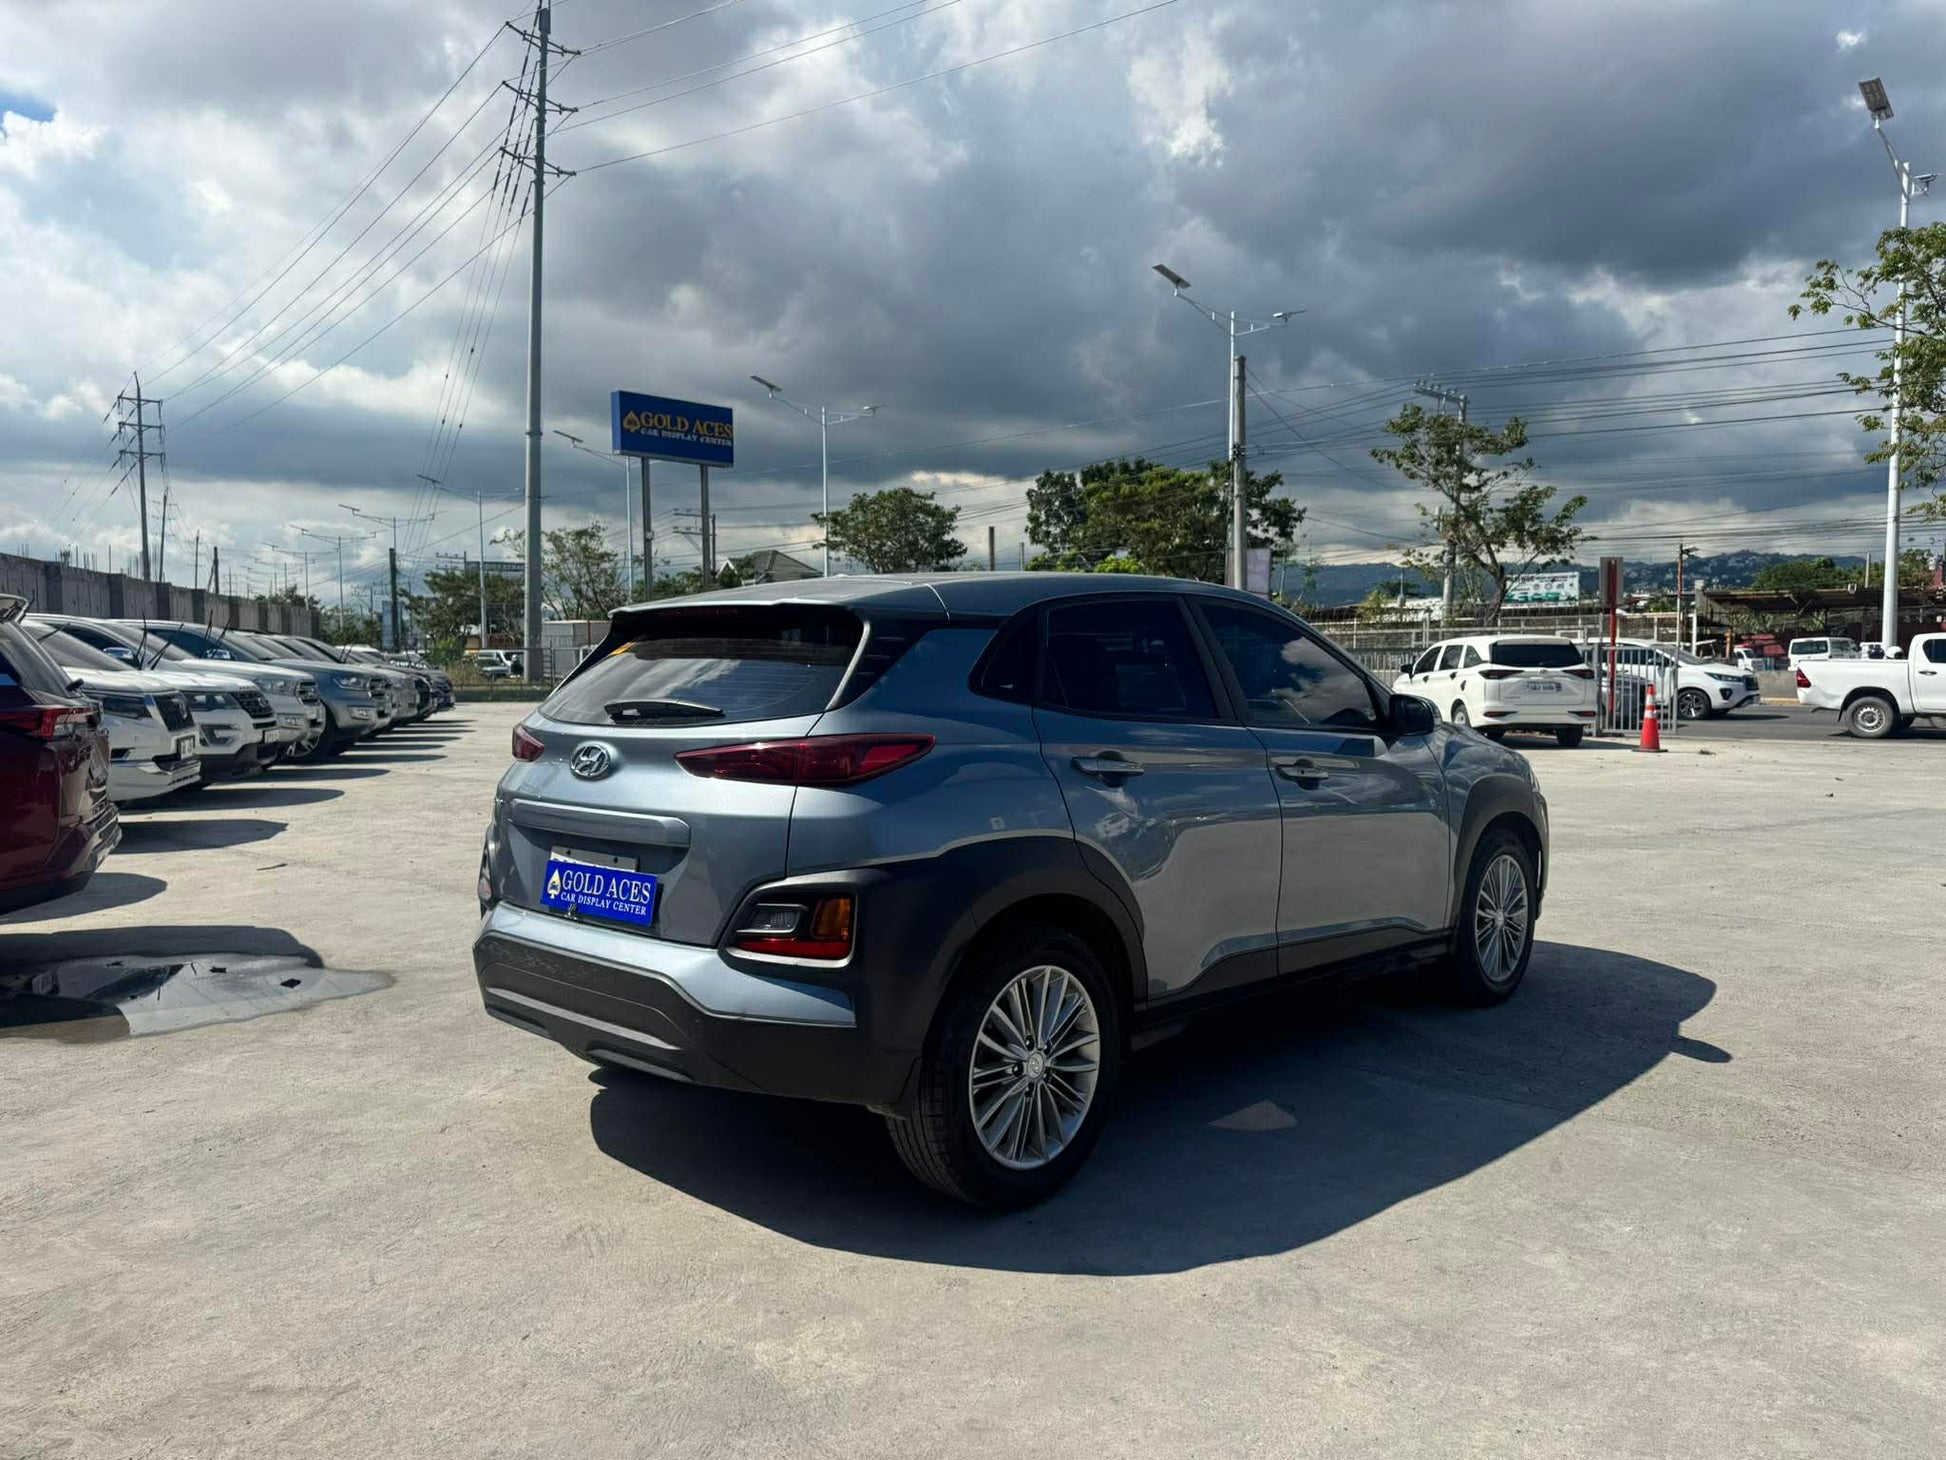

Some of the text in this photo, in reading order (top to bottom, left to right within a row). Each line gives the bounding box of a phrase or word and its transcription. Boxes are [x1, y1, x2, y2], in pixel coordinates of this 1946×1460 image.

[640, 412, 732, 437] GOLD ACES
[641, 427, 732, 446] CAR DISPLAY CENTER
[562, 870, 651, 904] GOLD ACES
[560, 892, 646, 915] CAR DISPLAY CENTER
